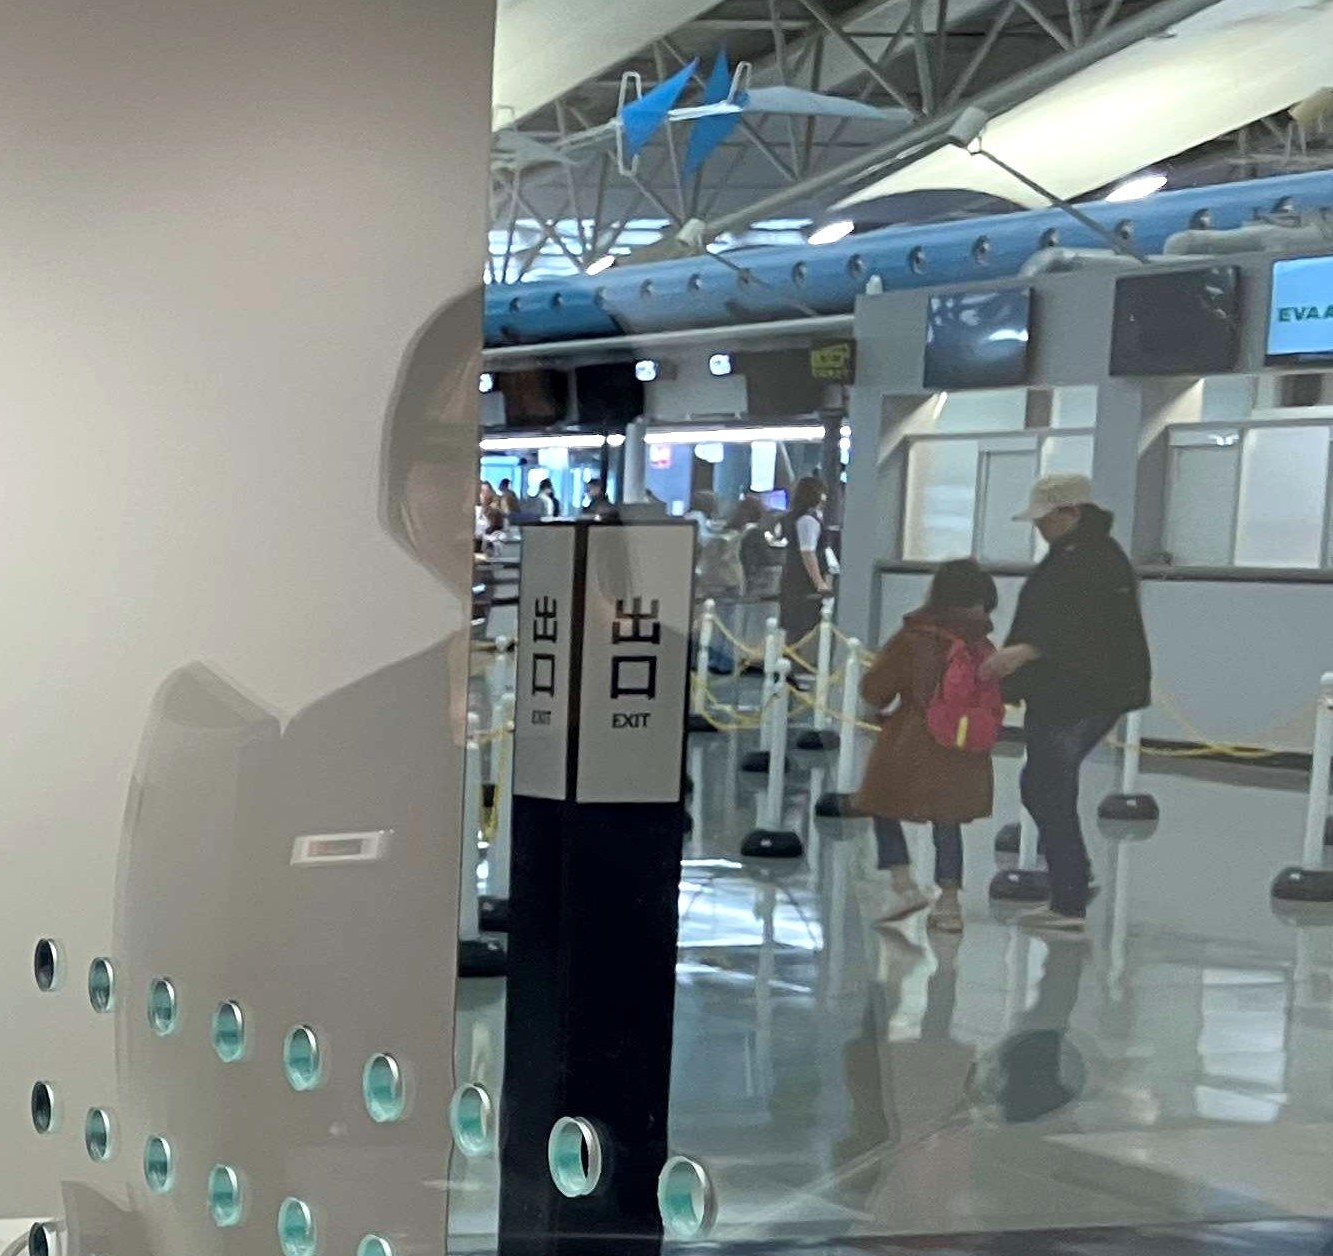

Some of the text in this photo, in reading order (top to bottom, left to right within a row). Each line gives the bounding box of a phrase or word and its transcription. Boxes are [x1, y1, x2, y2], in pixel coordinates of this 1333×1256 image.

[532, 596, 557, 698] 出口
[610, 596, 661, 700] 出口
[611, 712, 652, 729] EXIT
